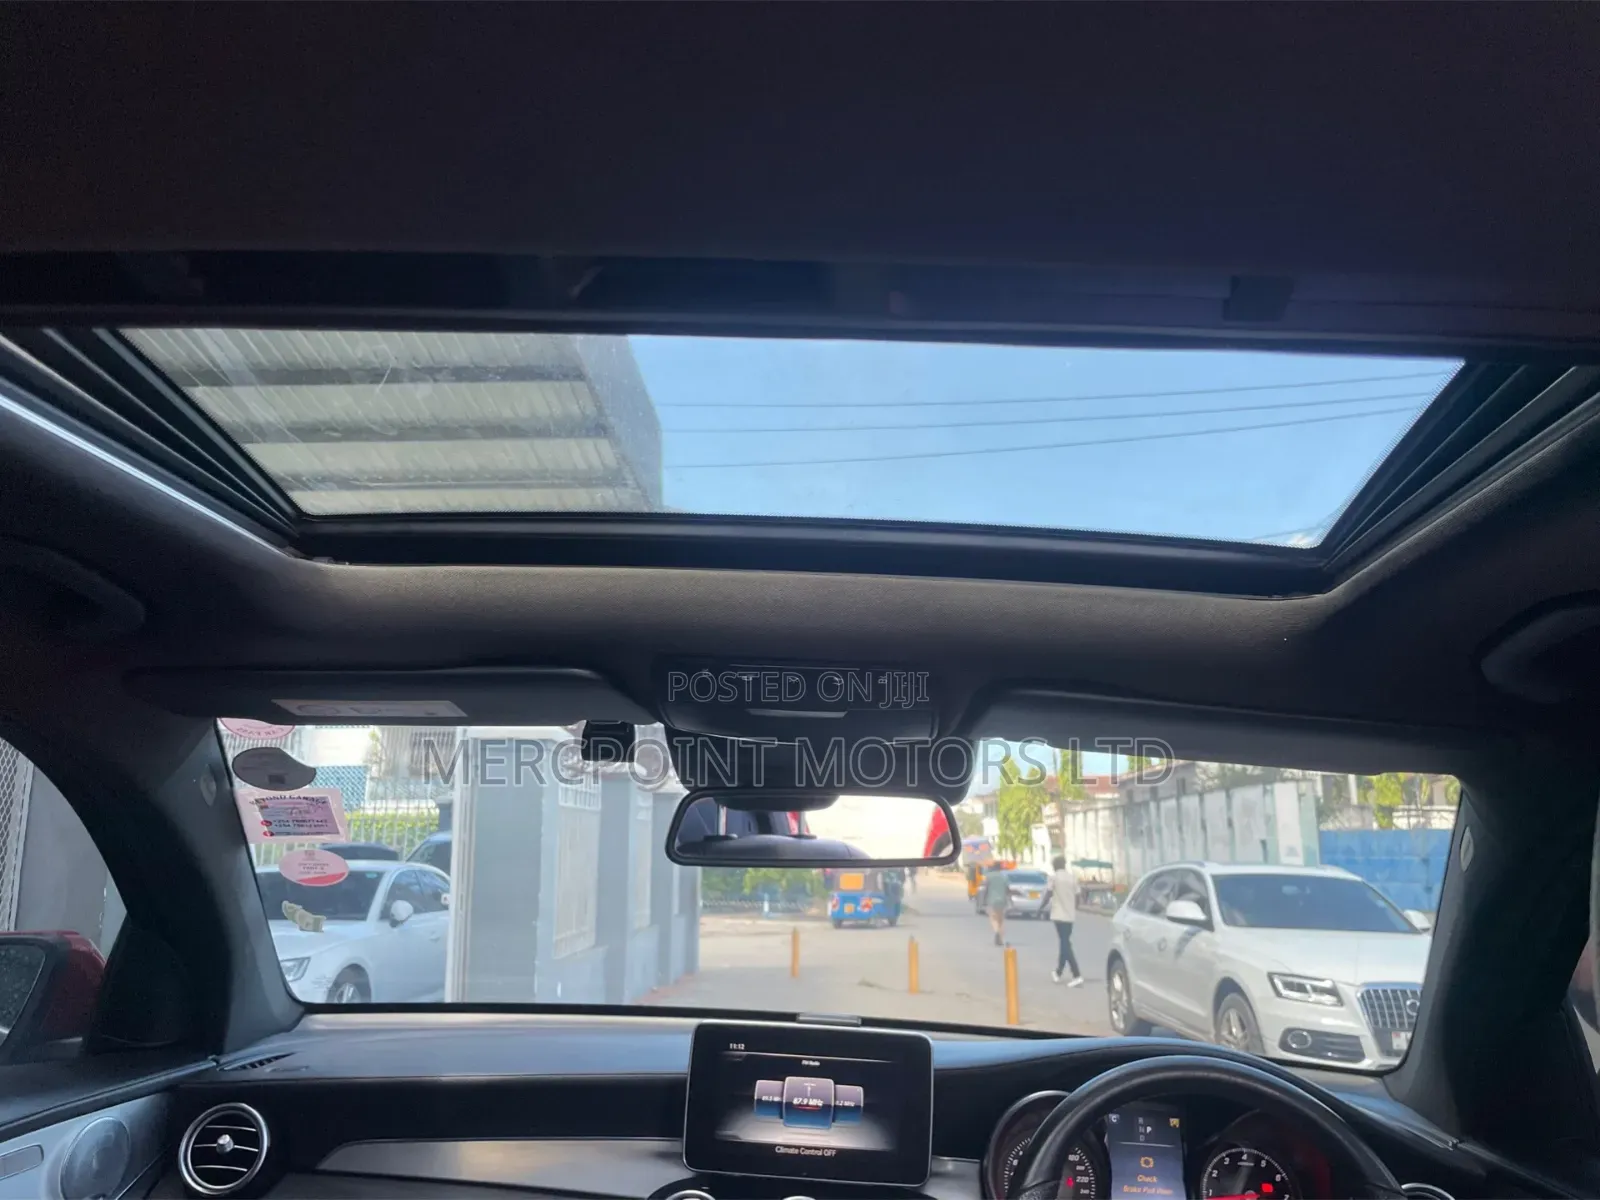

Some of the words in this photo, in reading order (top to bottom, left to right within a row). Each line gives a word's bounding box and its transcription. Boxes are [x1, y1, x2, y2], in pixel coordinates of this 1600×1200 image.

[792, 1097, 808, 1105] 87.9
[775, 1146, 799, 1155] Climate
[799, 1147, 823, 1156] Control
[823, 1149, 837, 1157] OFF
[1223, 1157, 1230, 1165] 3
[1275, 1174, 1282, 1182] 6
